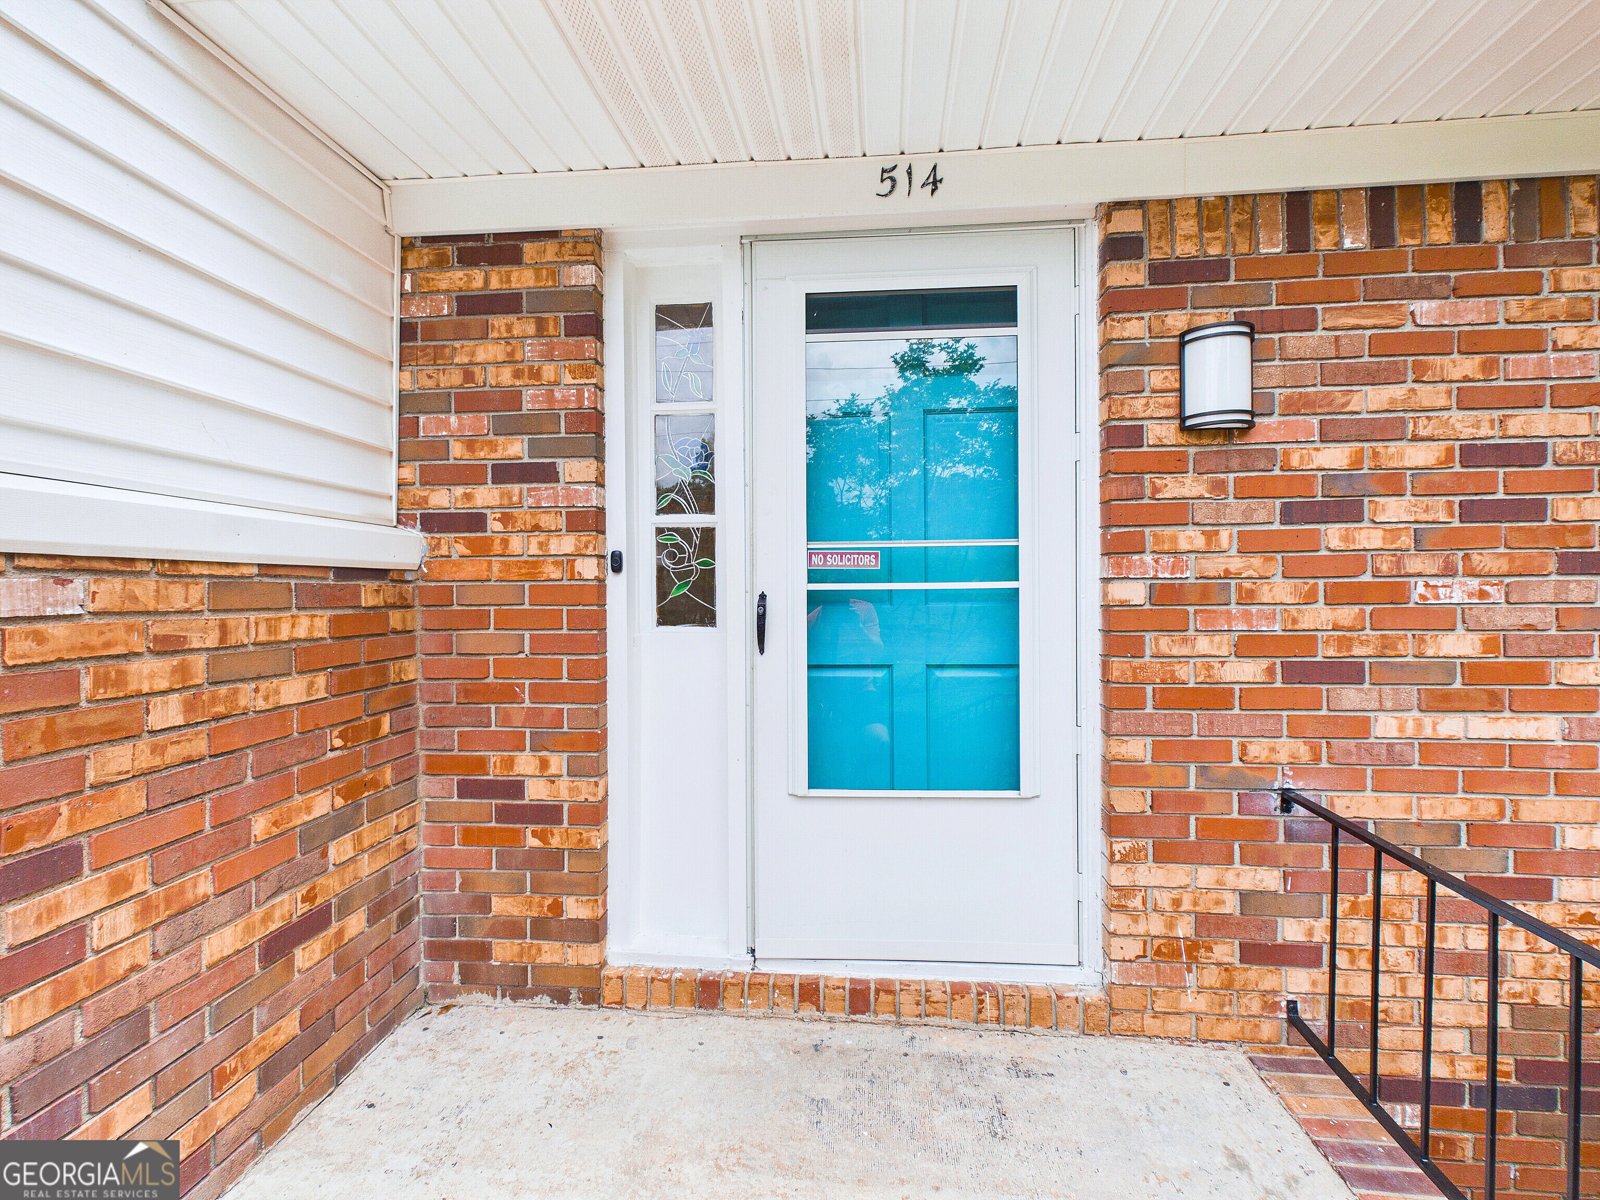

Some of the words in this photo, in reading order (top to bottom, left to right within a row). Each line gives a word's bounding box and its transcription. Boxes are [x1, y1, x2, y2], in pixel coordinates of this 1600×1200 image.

[876, 162, 943, 197] 514
[811, 554, 824, 565] NO
[826, 554, 876, 565] SOLICITORS
